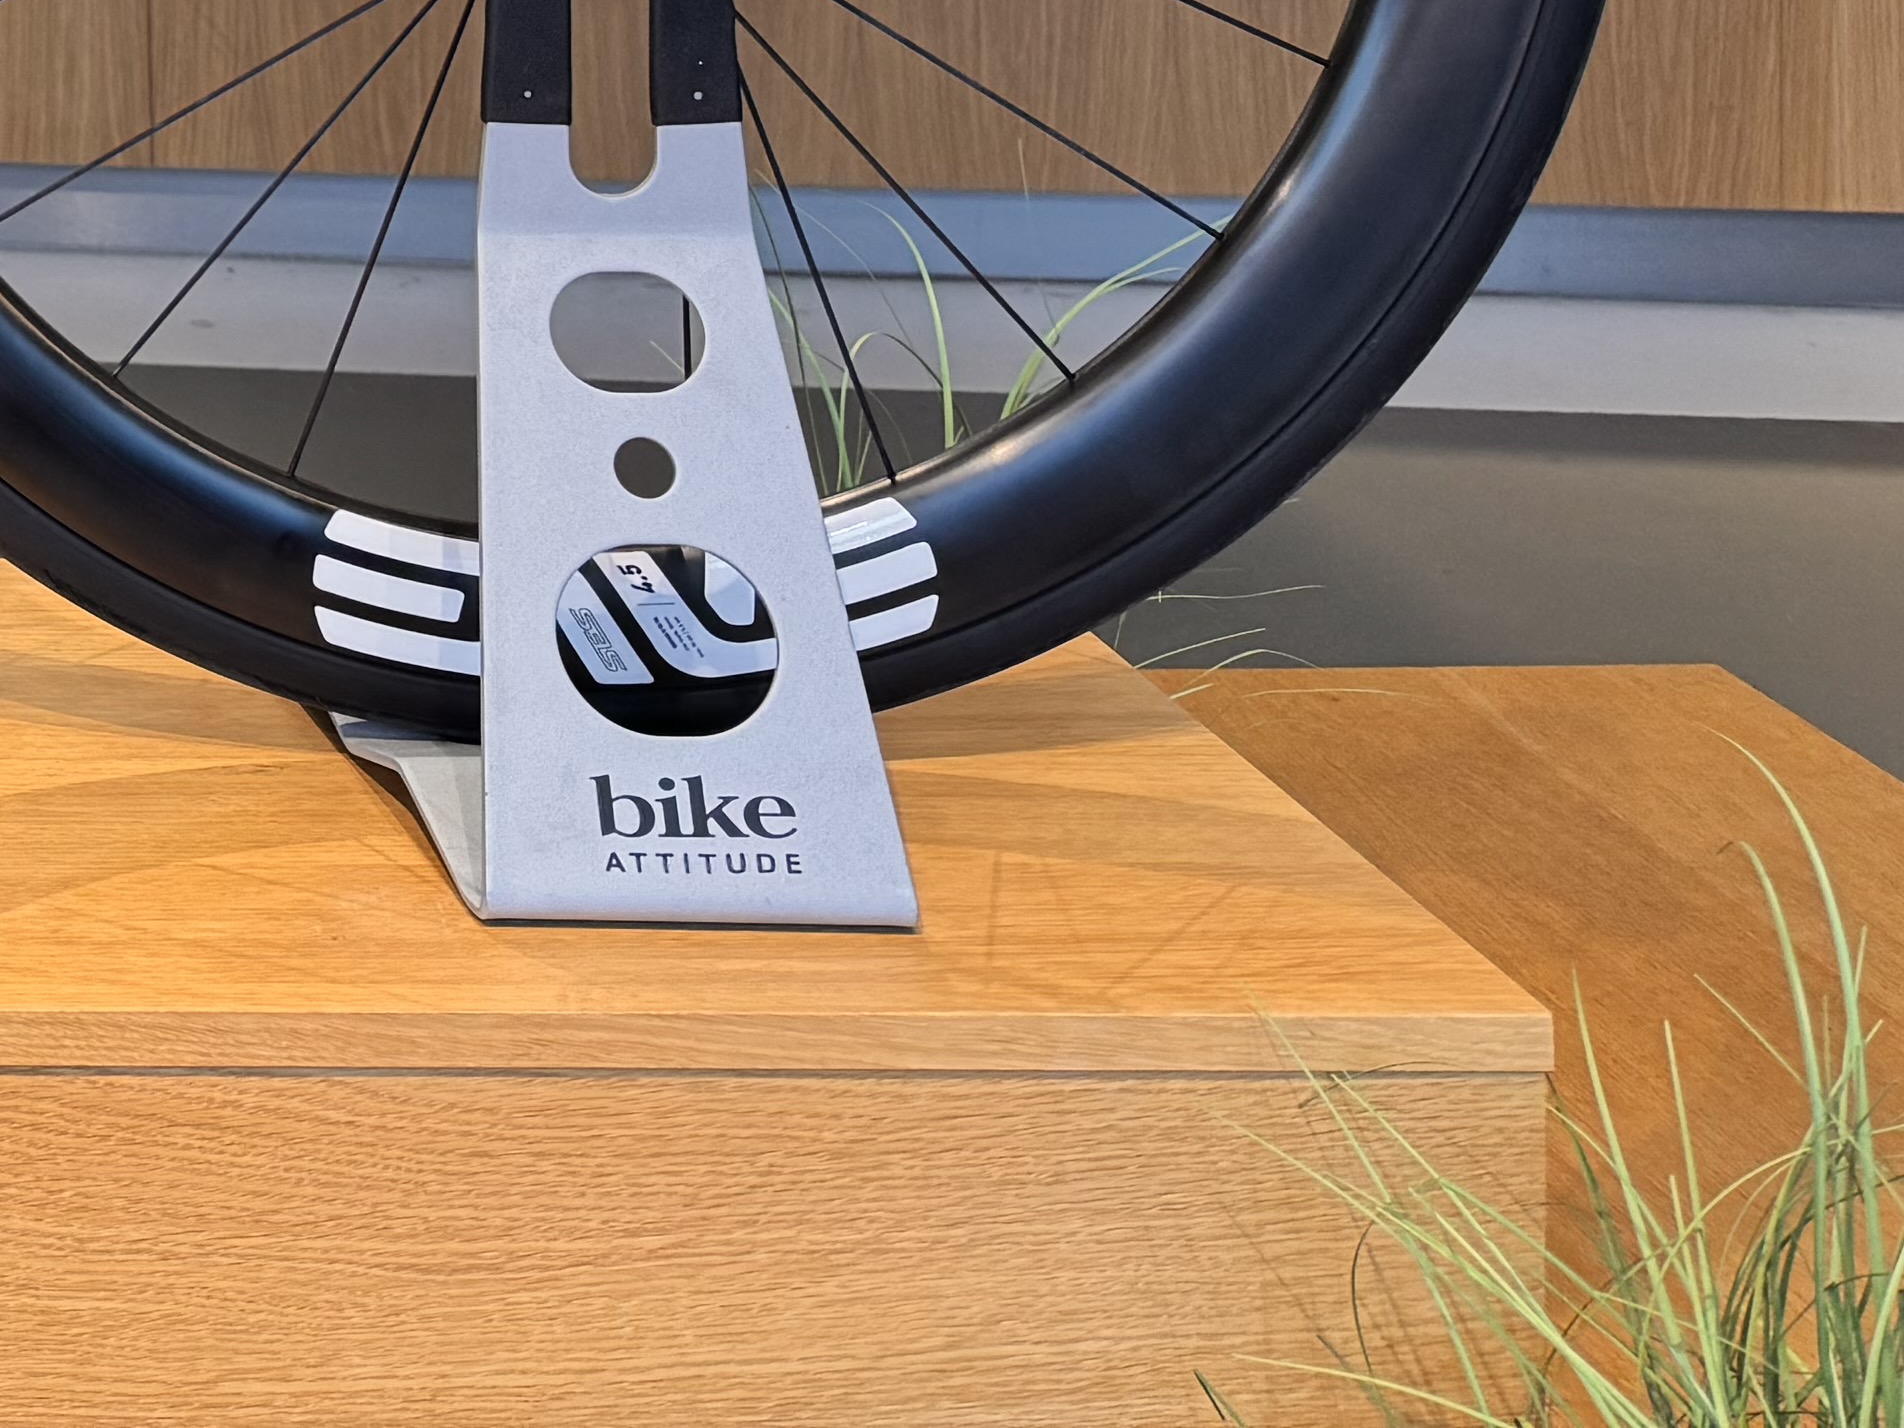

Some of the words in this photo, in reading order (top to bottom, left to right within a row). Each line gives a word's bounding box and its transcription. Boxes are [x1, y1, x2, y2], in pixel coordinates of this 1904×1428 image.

[616, 564, 656, 594] 4.5
[568, 607, 628, 673] SES
[588, 774, 798, 840] bike
[605, 851, 804, 875] ATTITUDE
